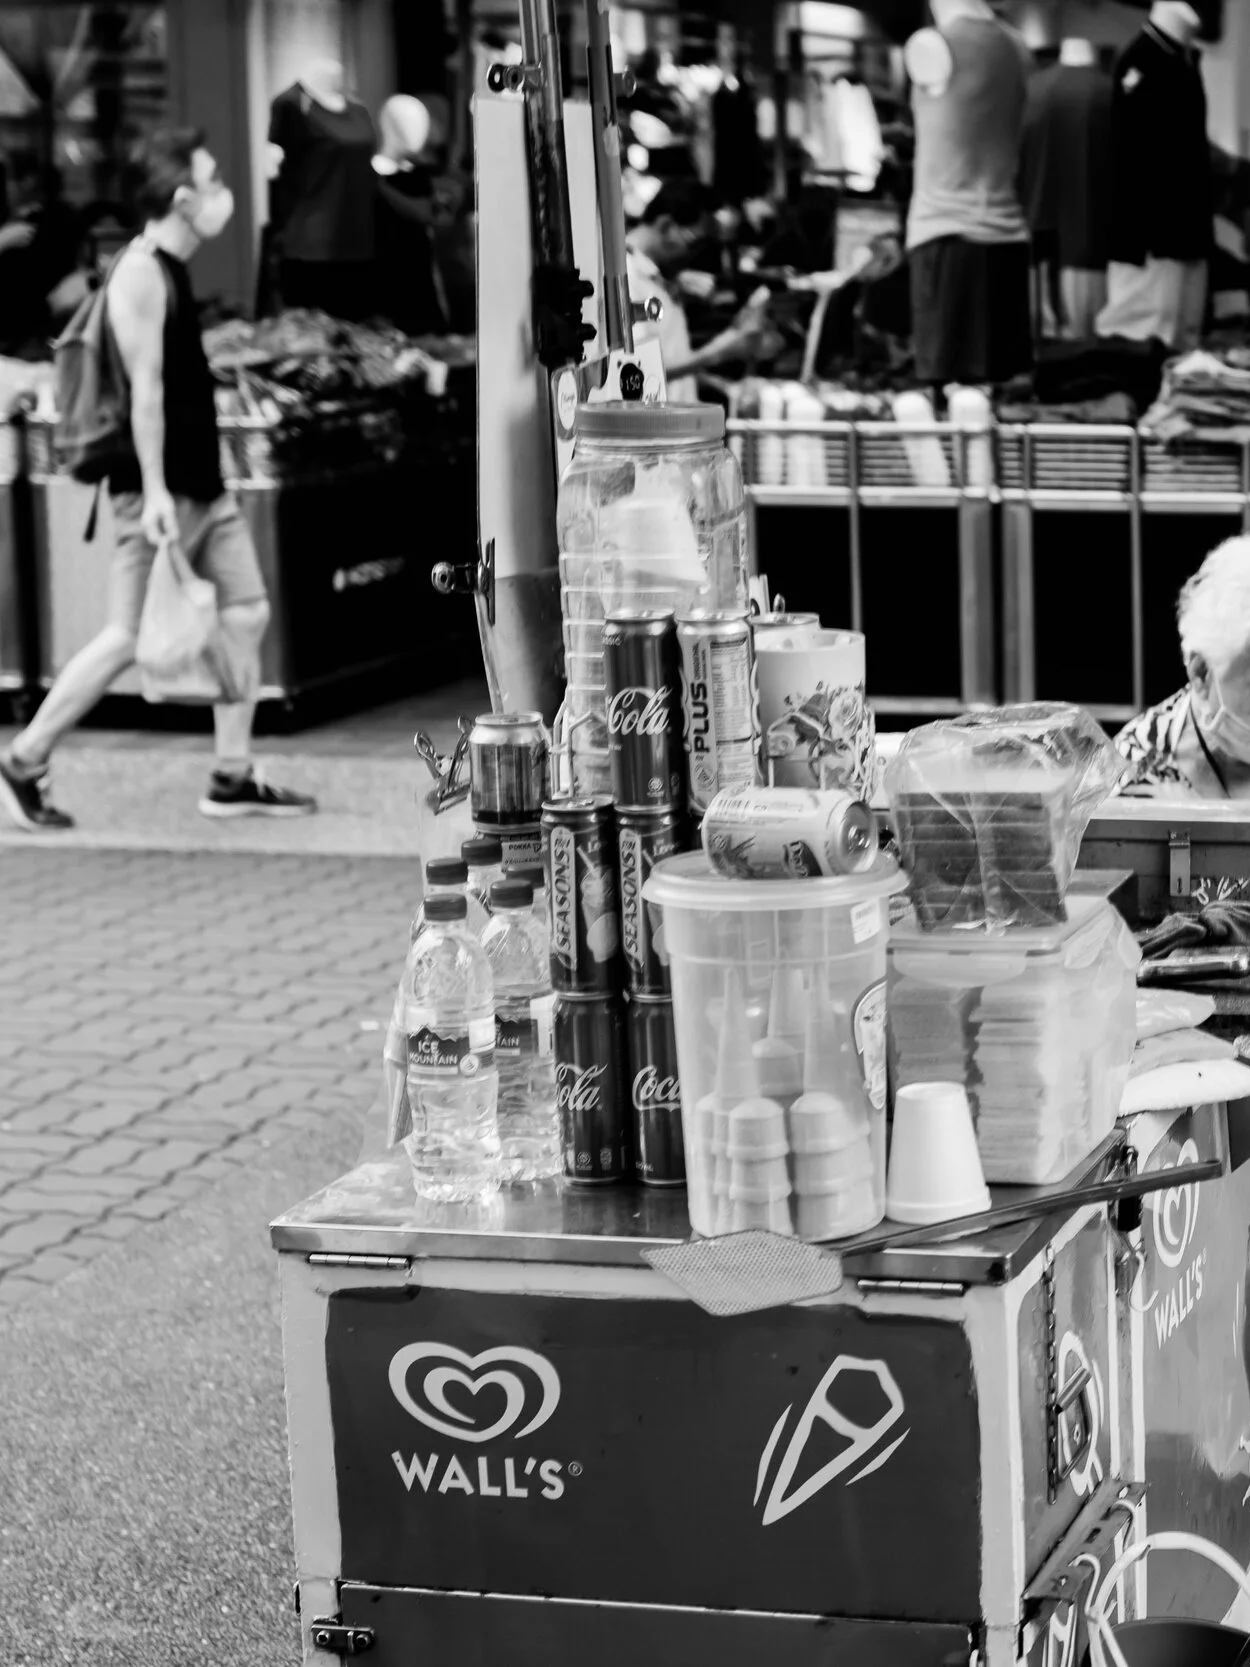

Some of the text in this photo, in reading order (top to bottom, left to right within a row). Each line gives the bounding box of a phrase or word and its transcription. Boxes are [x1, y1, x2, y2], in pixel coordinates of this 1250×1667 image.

[690, 681, 710, 753] PLUS
[554, 849, 572, 951] SEASONS
[621, 850, 638, 953] SEASONS
[417, 1040, 440, 1054] ICE
[1154, 1253, 1203, 1350] WALL'S
[391, 1449, 565, 1500] WALL'S
